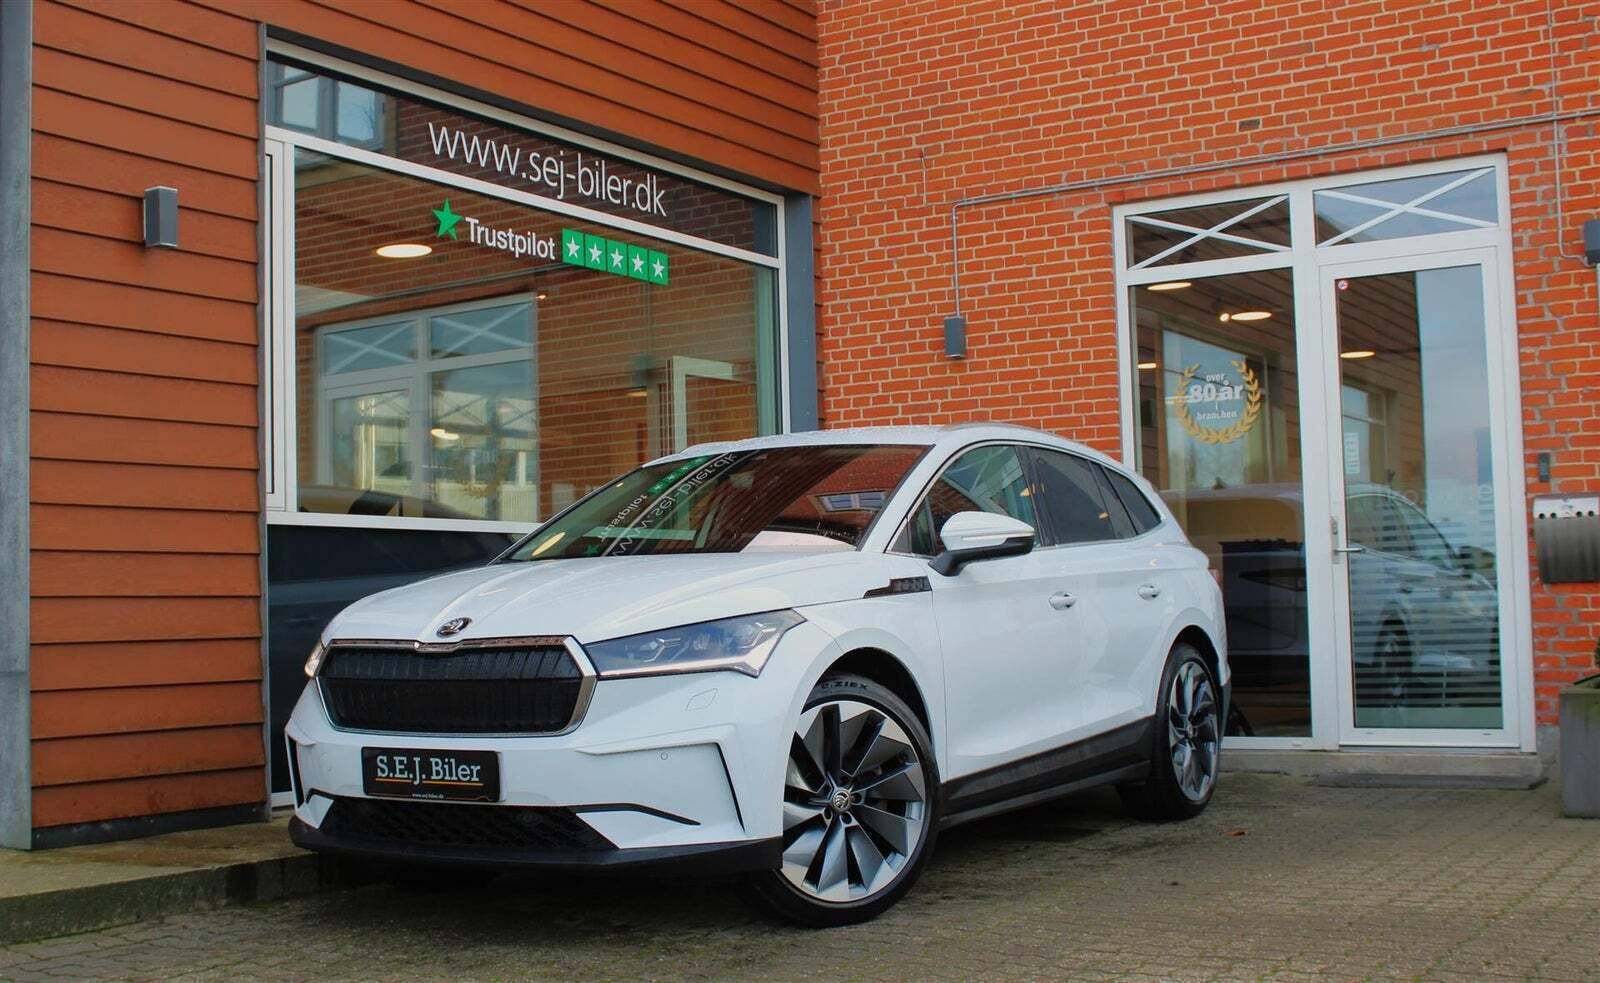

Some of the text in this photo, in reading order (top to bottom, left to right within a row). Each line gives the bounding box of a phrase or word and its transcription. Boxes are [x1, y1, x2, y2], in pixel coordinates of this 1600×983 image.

[428, 122, 667, 216] www.sej-biler.dk
[465, 216, 556, 260] Trustpilot
[1206, 373, 1225, 382] over
[1191, 380, 1244, 402] 80 år
[1197, 410, 1237, 420] branchen
[376, 755, 481, 785] S.E.J. Biler
